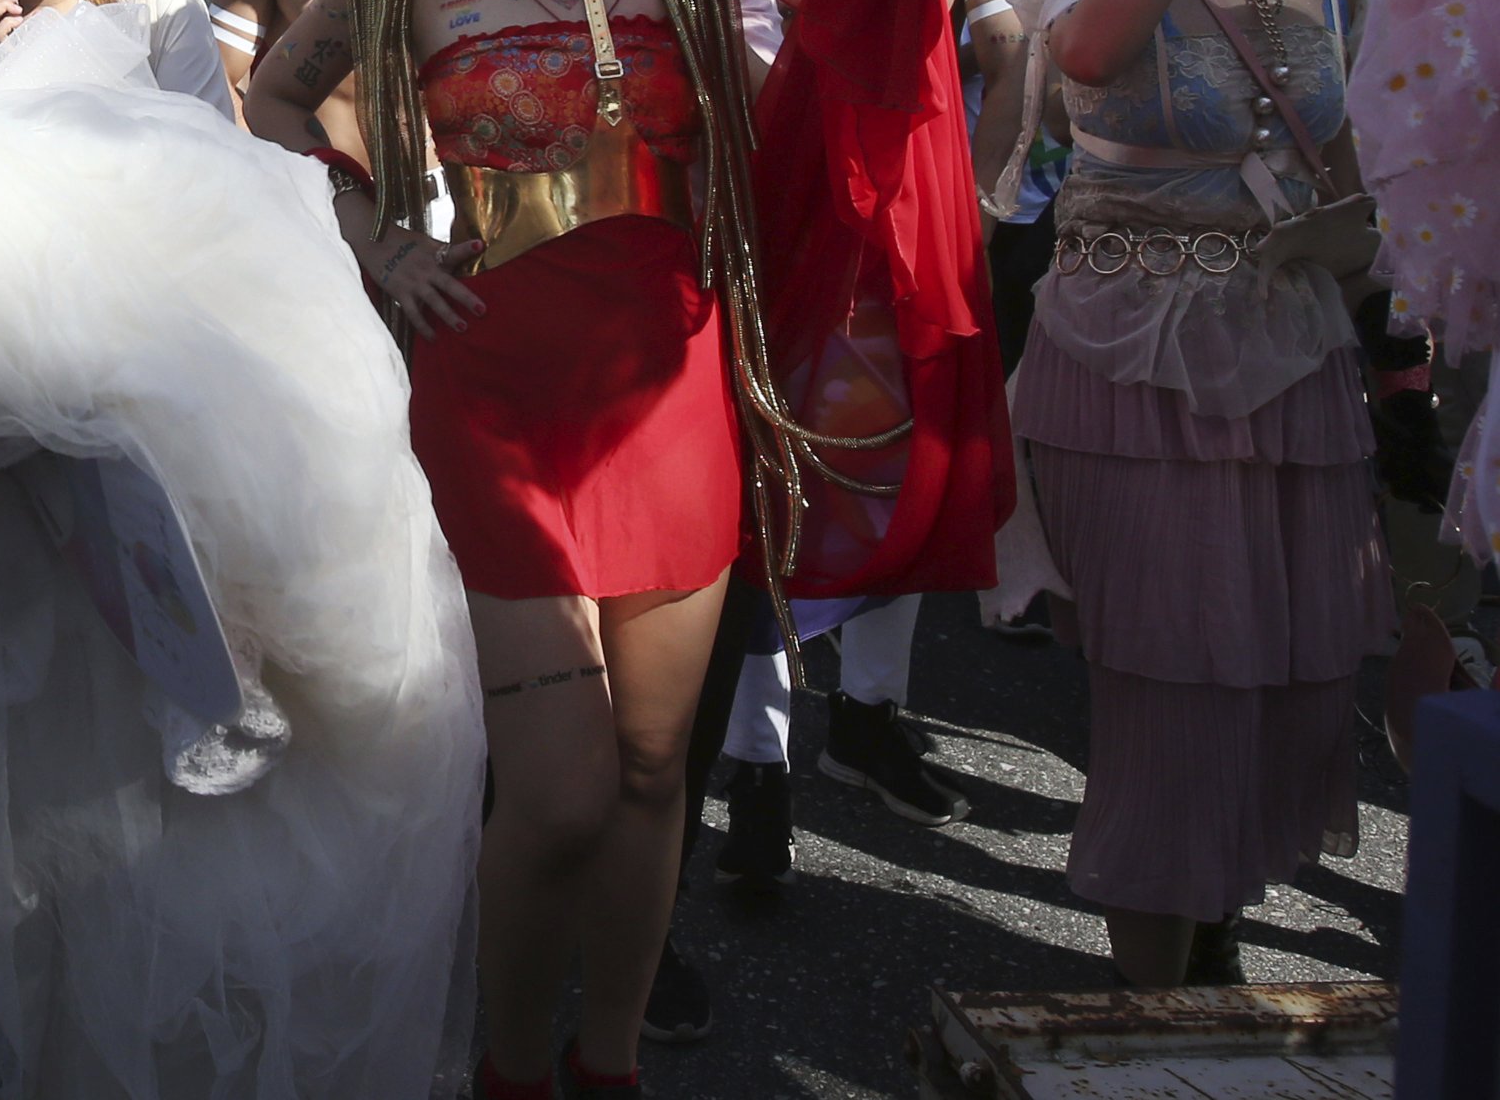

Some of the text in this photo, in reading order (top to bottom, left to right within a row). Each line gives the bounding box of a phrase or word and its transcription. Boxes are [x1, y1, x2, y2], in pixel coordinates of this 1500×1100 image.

[450, 12, 481, 29] LOVE
[384, 241, 418, 272] tinder
[539, 670, 572, 686] tinder
